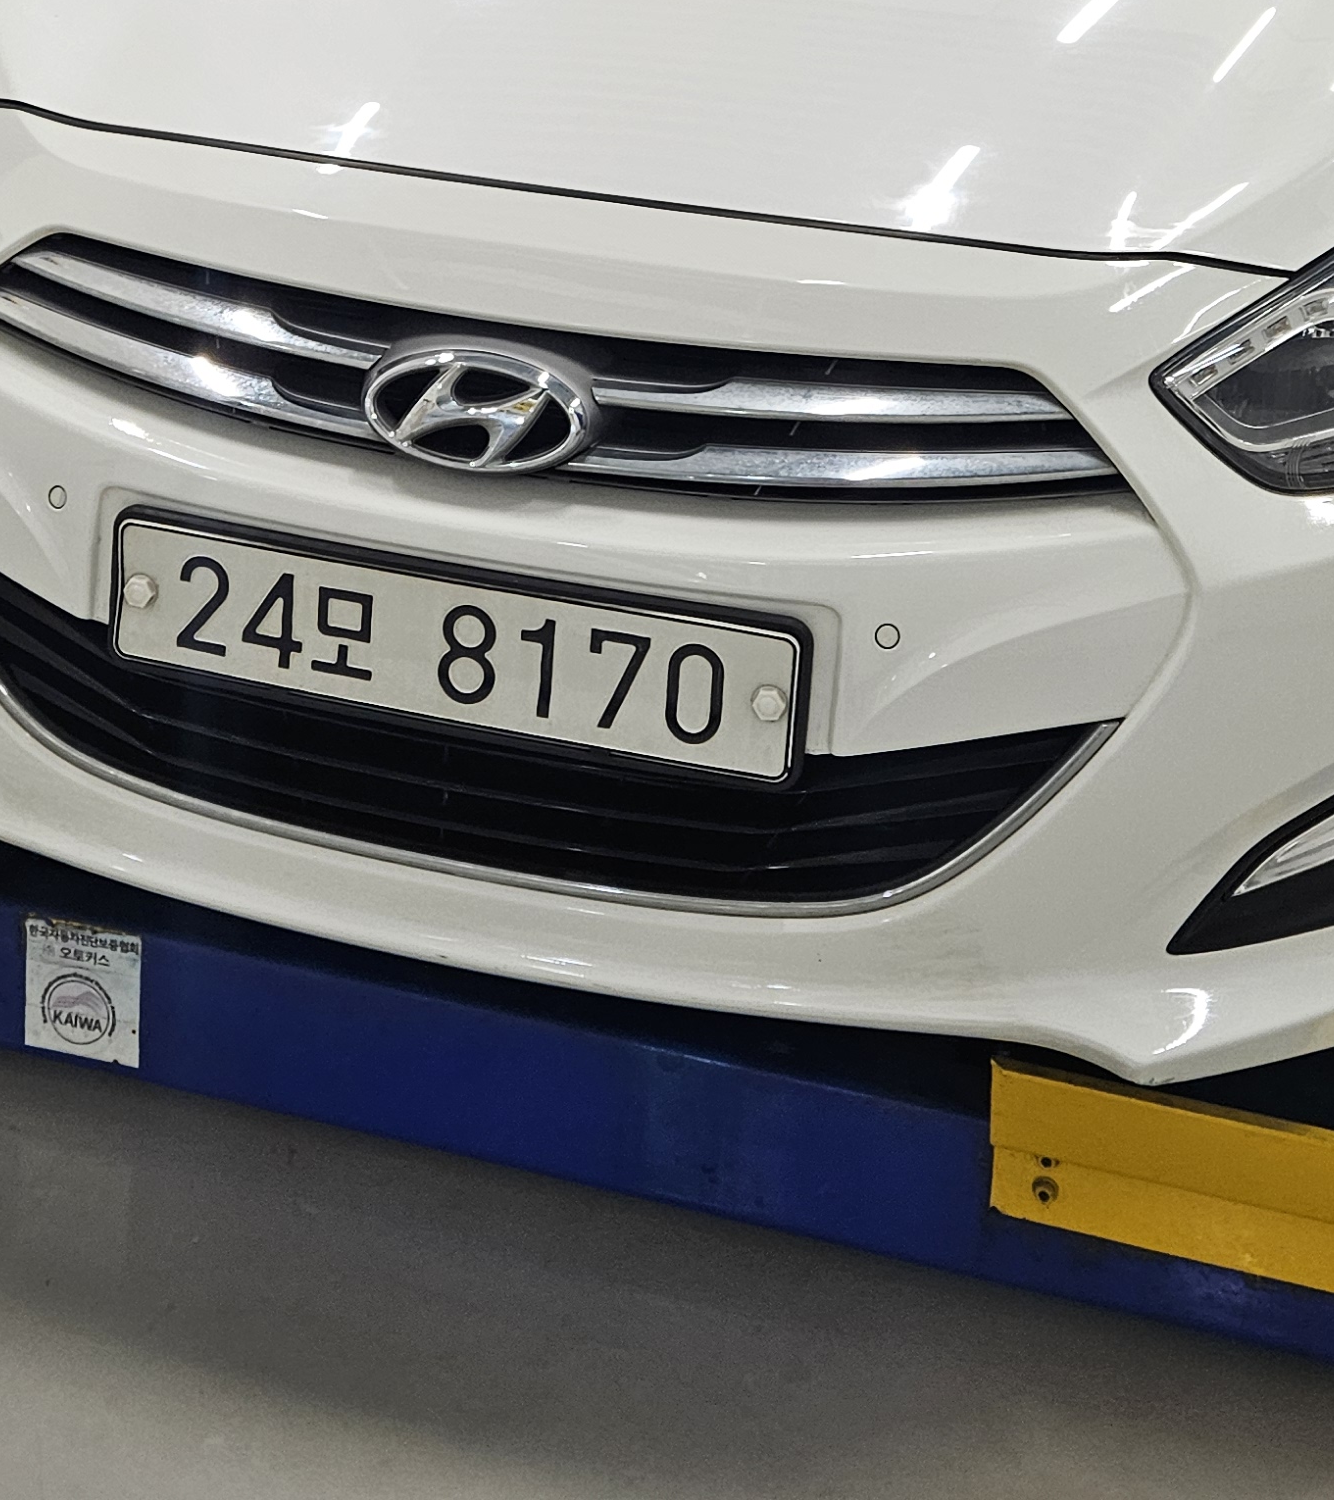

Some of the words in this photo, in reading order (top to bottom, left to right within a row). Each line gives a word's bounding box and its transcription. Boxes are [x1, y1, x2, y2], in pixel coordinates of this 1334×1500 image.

[176, 556, 373, 682] 24모
[437, 604, 724, 744] 8170
[52, 1009, 102, 1033] KAIWA
